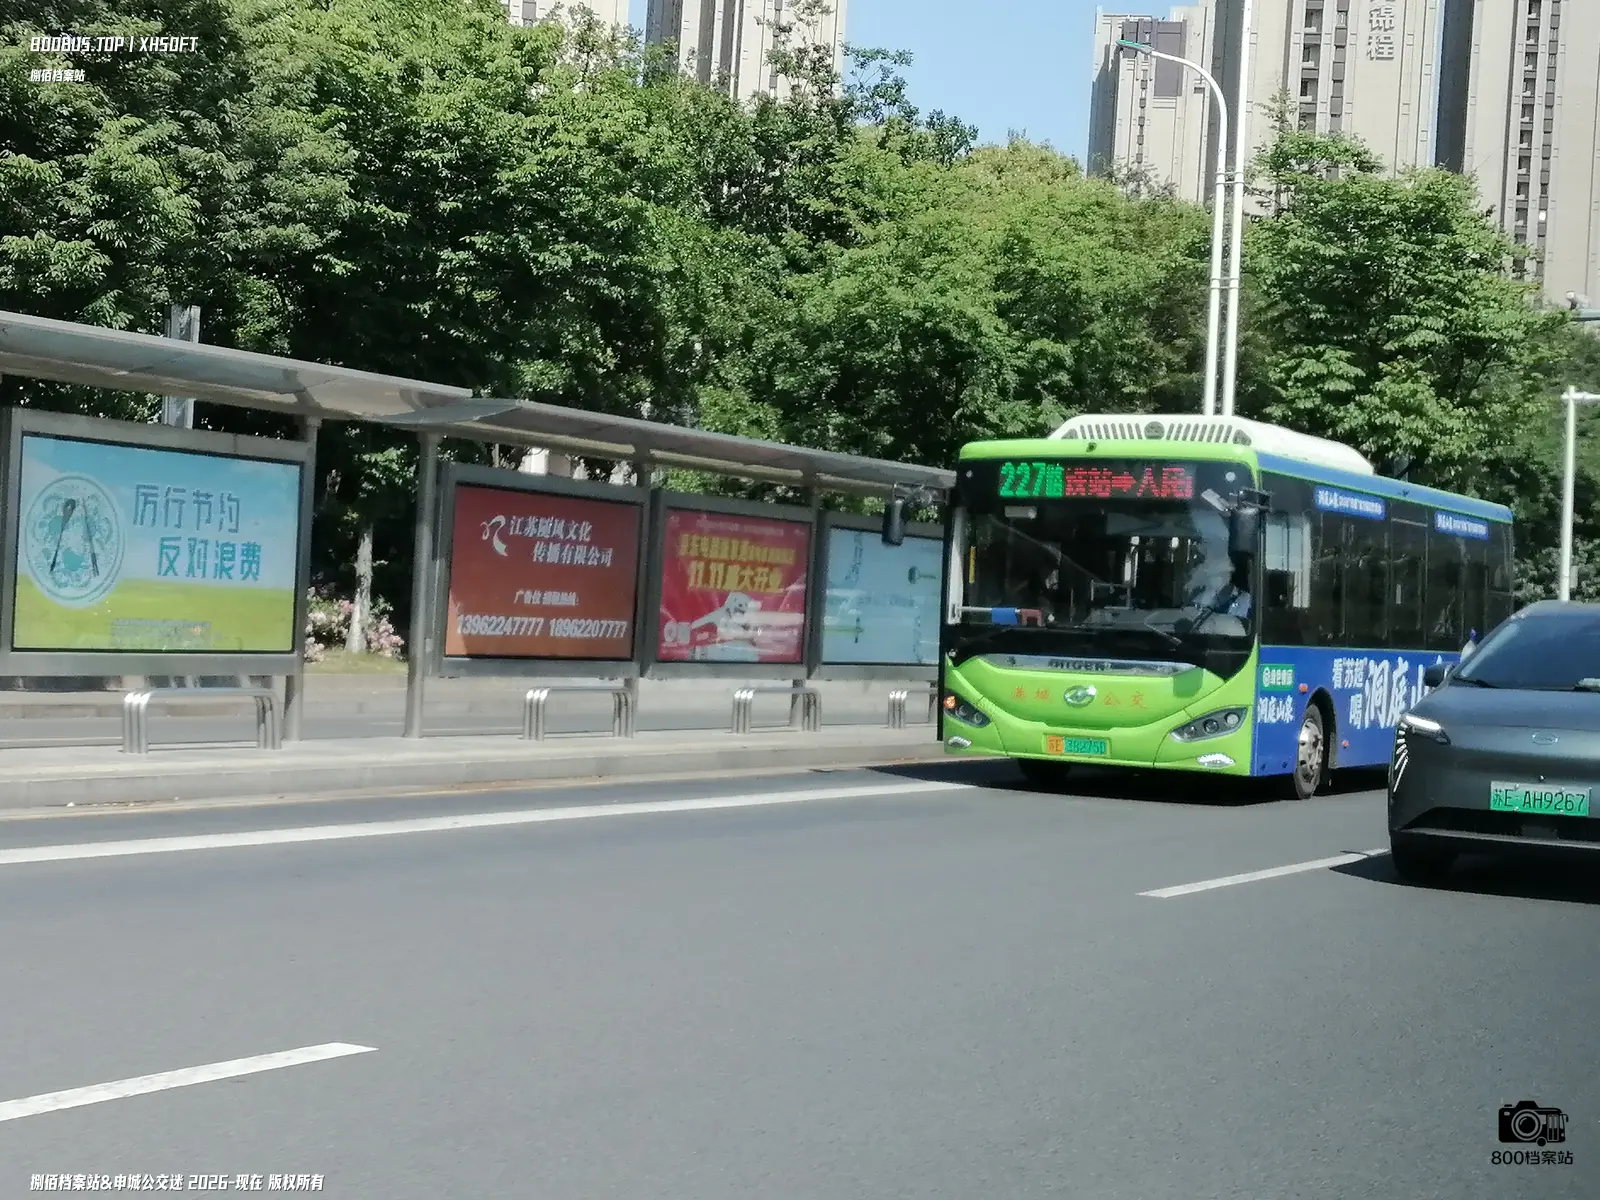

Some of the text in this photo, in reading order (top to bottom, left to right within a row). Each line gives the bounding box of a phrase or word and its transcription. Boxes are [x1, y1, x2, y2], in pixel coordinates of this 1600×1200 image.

[1366, 0, 1395, 61] 锦程
[132, 484, 241, 534] 厉行节约
[156, 535, 263, 582] 反对浪费
